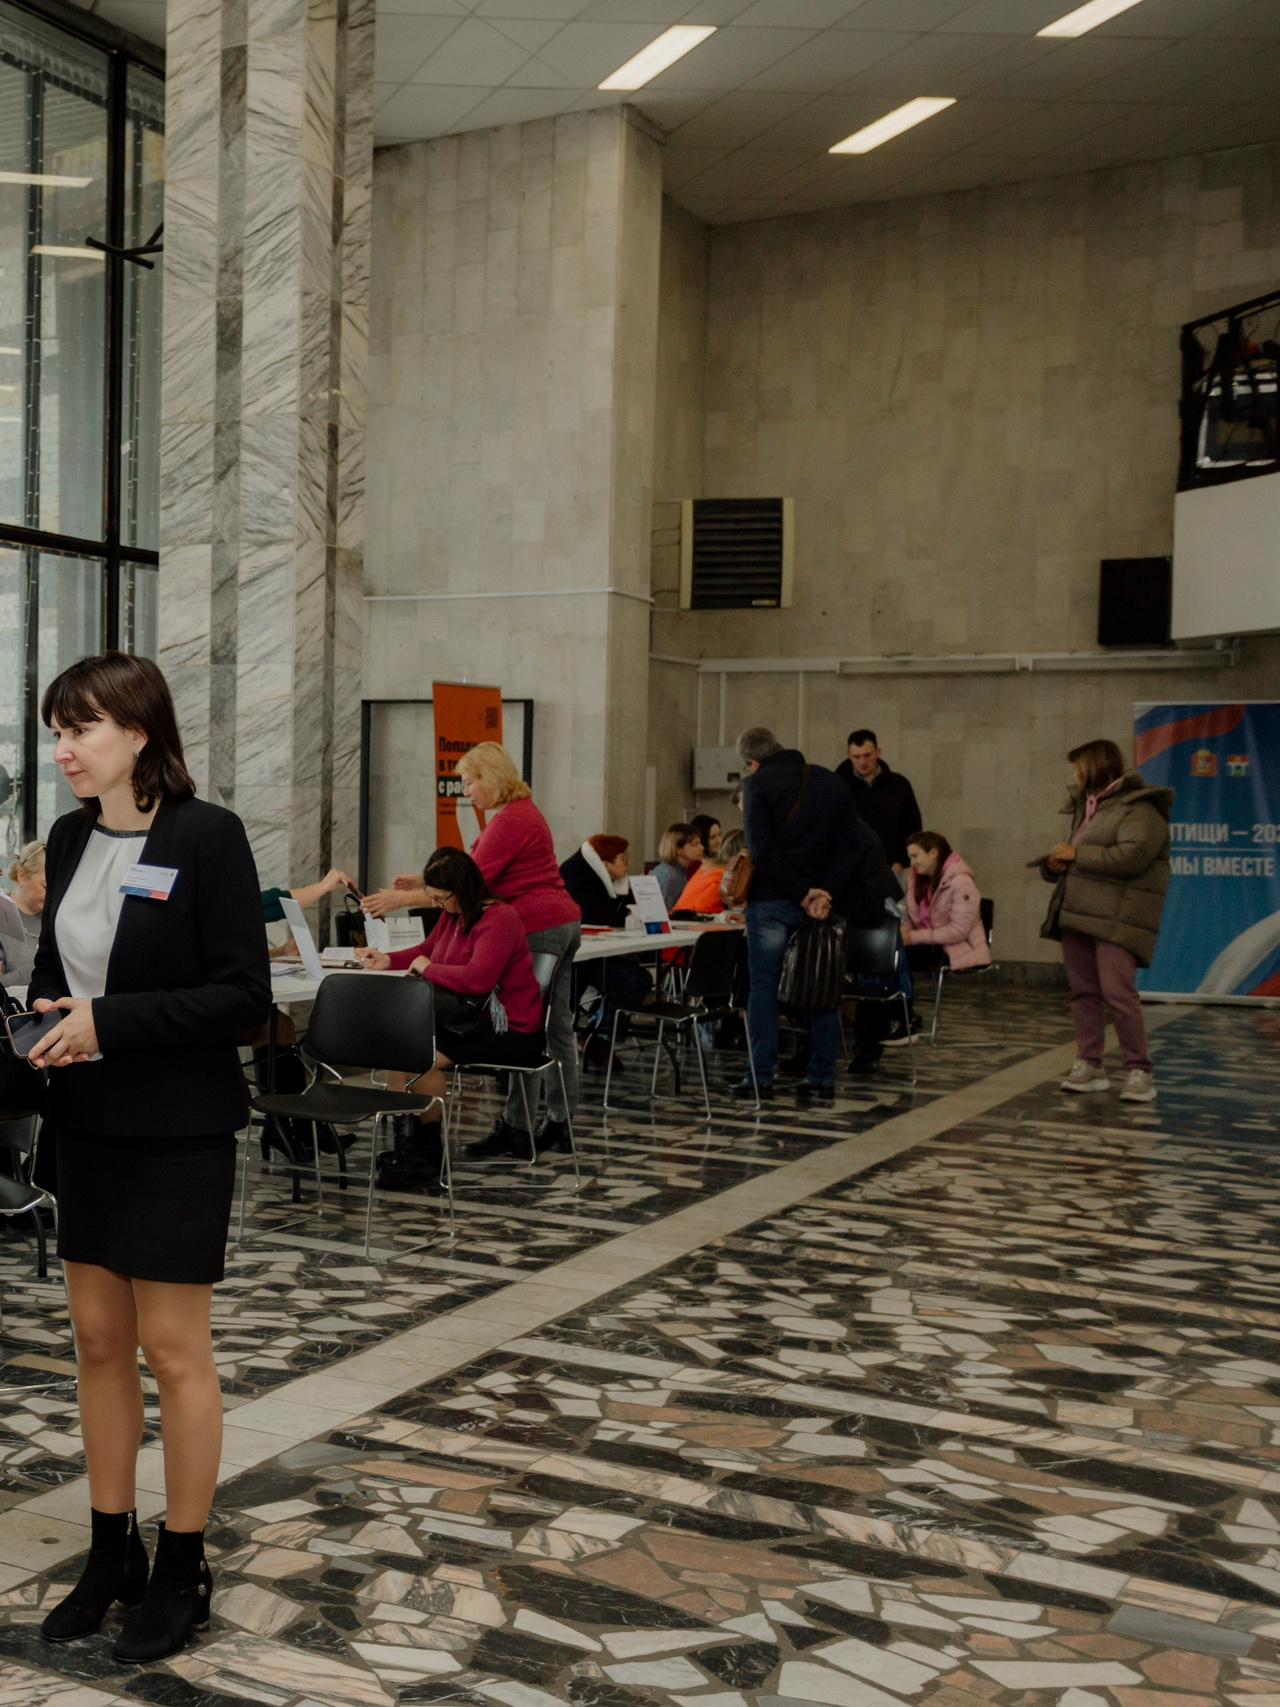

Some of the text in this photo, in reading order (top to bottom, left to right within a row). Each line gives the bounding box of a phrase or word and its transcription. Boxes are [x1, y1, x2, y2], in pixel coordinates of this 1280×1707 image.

[438, 780, 445, 794] с
[1252, 823, 1280, 843] 20
[1203, 857, 1275, 877] ВМЕСТЕ
